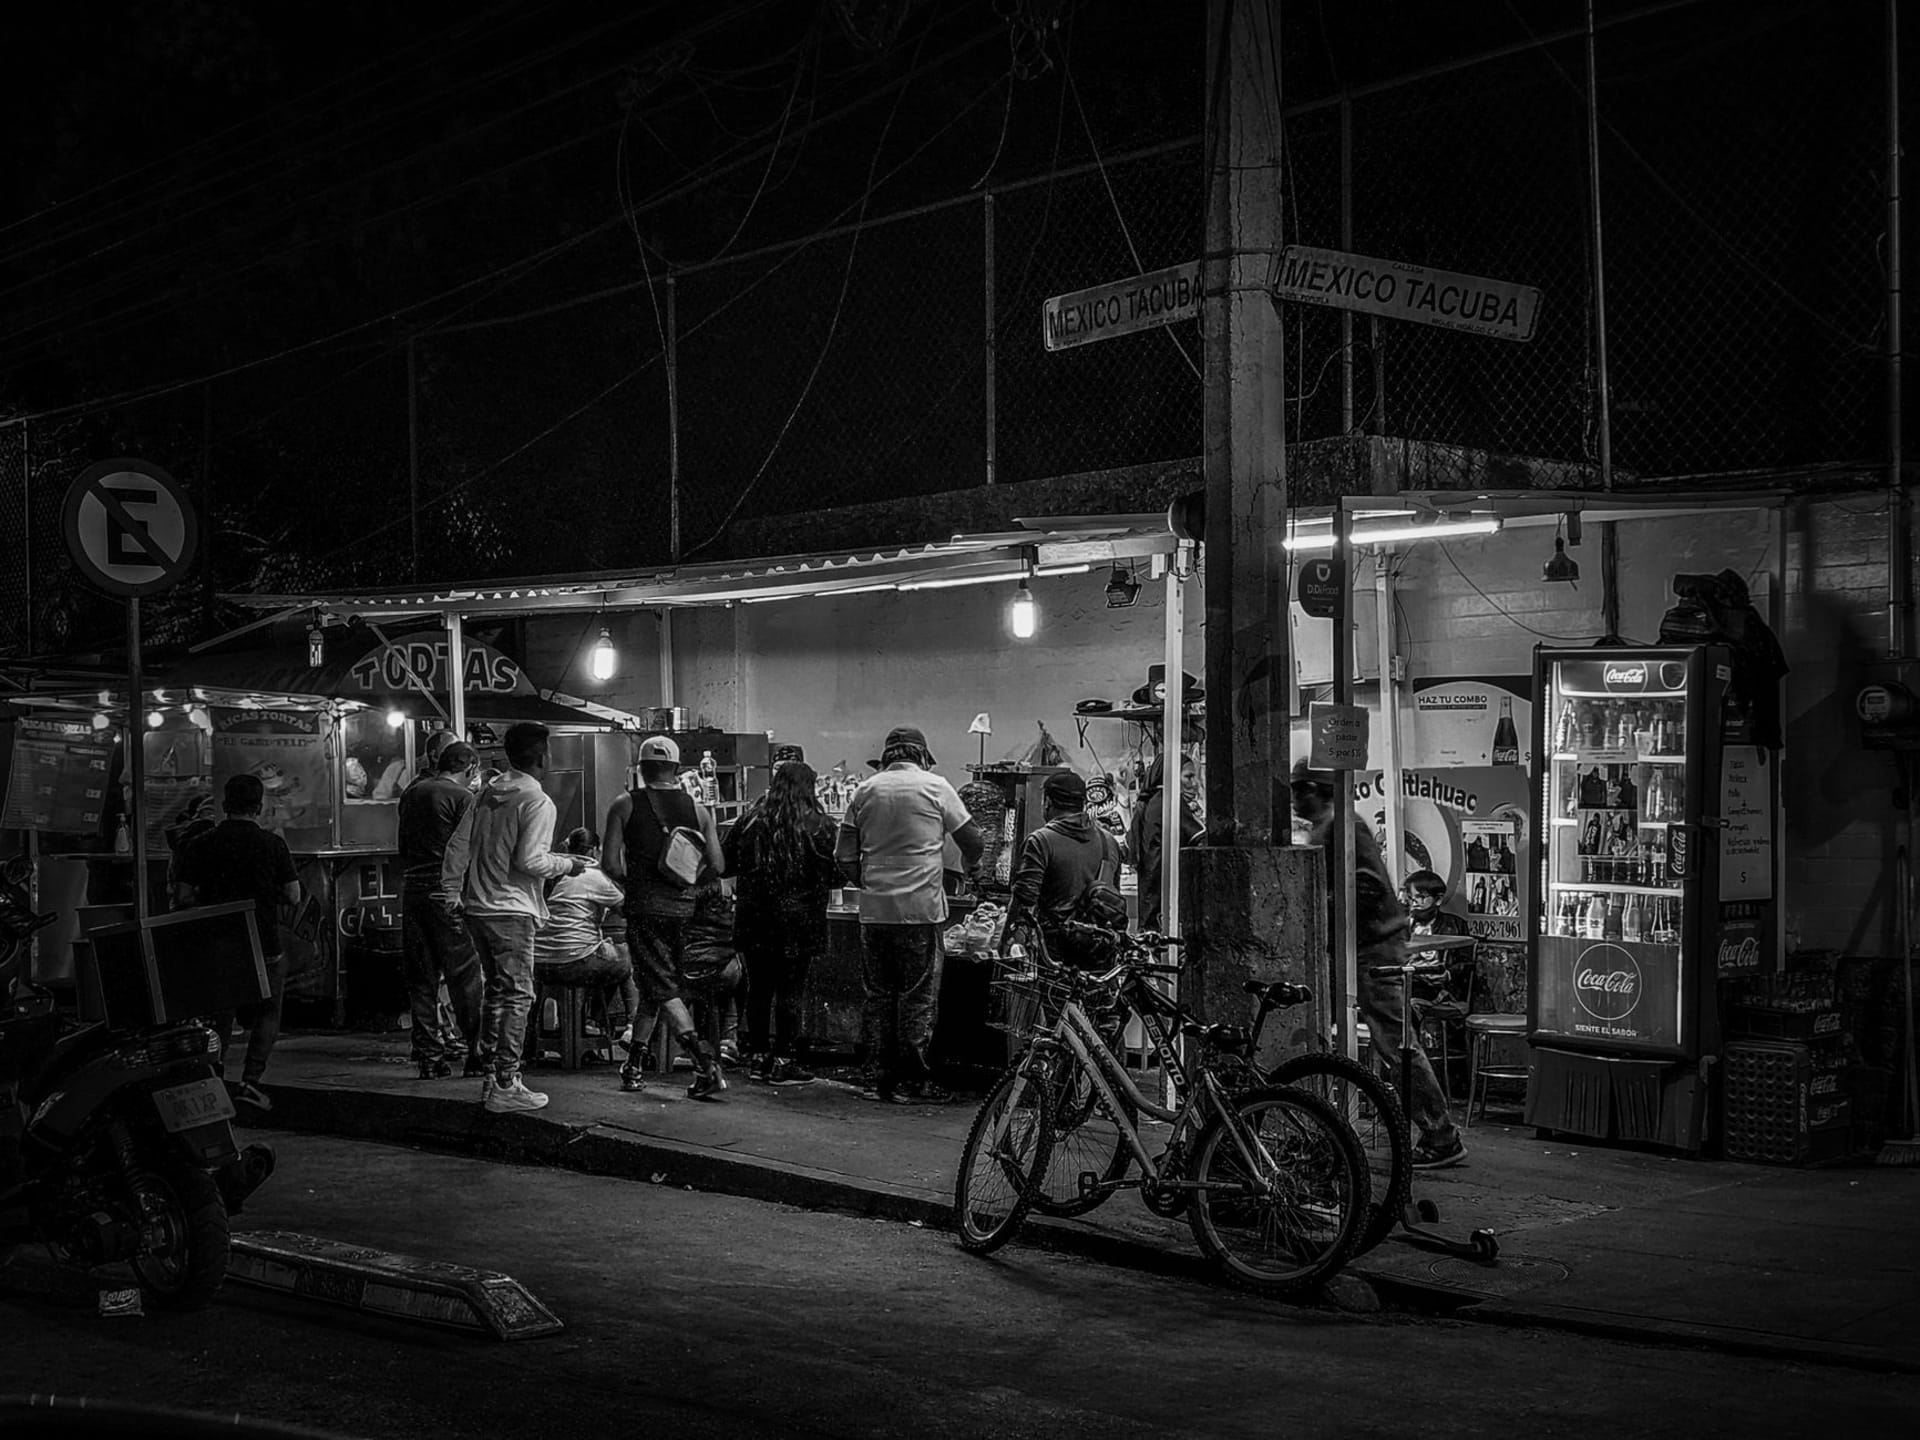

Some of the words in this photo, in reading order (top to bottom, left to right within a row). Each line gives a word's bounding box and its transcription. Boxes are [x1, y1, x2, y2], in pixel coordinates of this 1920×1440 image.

[1049, 295, 1121, 339] MEXICO
[1126, 274, 1205, 320] TACUBA
[1284, 259, 1396, 303] MEXICO
[1406, 278, 1518, 327] TACUBA
[1606, 668, 1645, 683] Coca-Cola
[1418, 696, 1438, 704] HAZ
[1439, 696, 1452, 704] TU
[1453, 695, 1488, 704] COMBO
[1374, 772, 1478, 812] Citlahuac
[1577, 968, 1638, 993] Coca-Cola
[1574, 1024, 1601, 1034] SIENTE
[1601, 1025, 1611, 1035] EL
[1611, 1027, 1638, 1037] SABOR
[1142, 1013, 1187, 1086] BENOTTO
